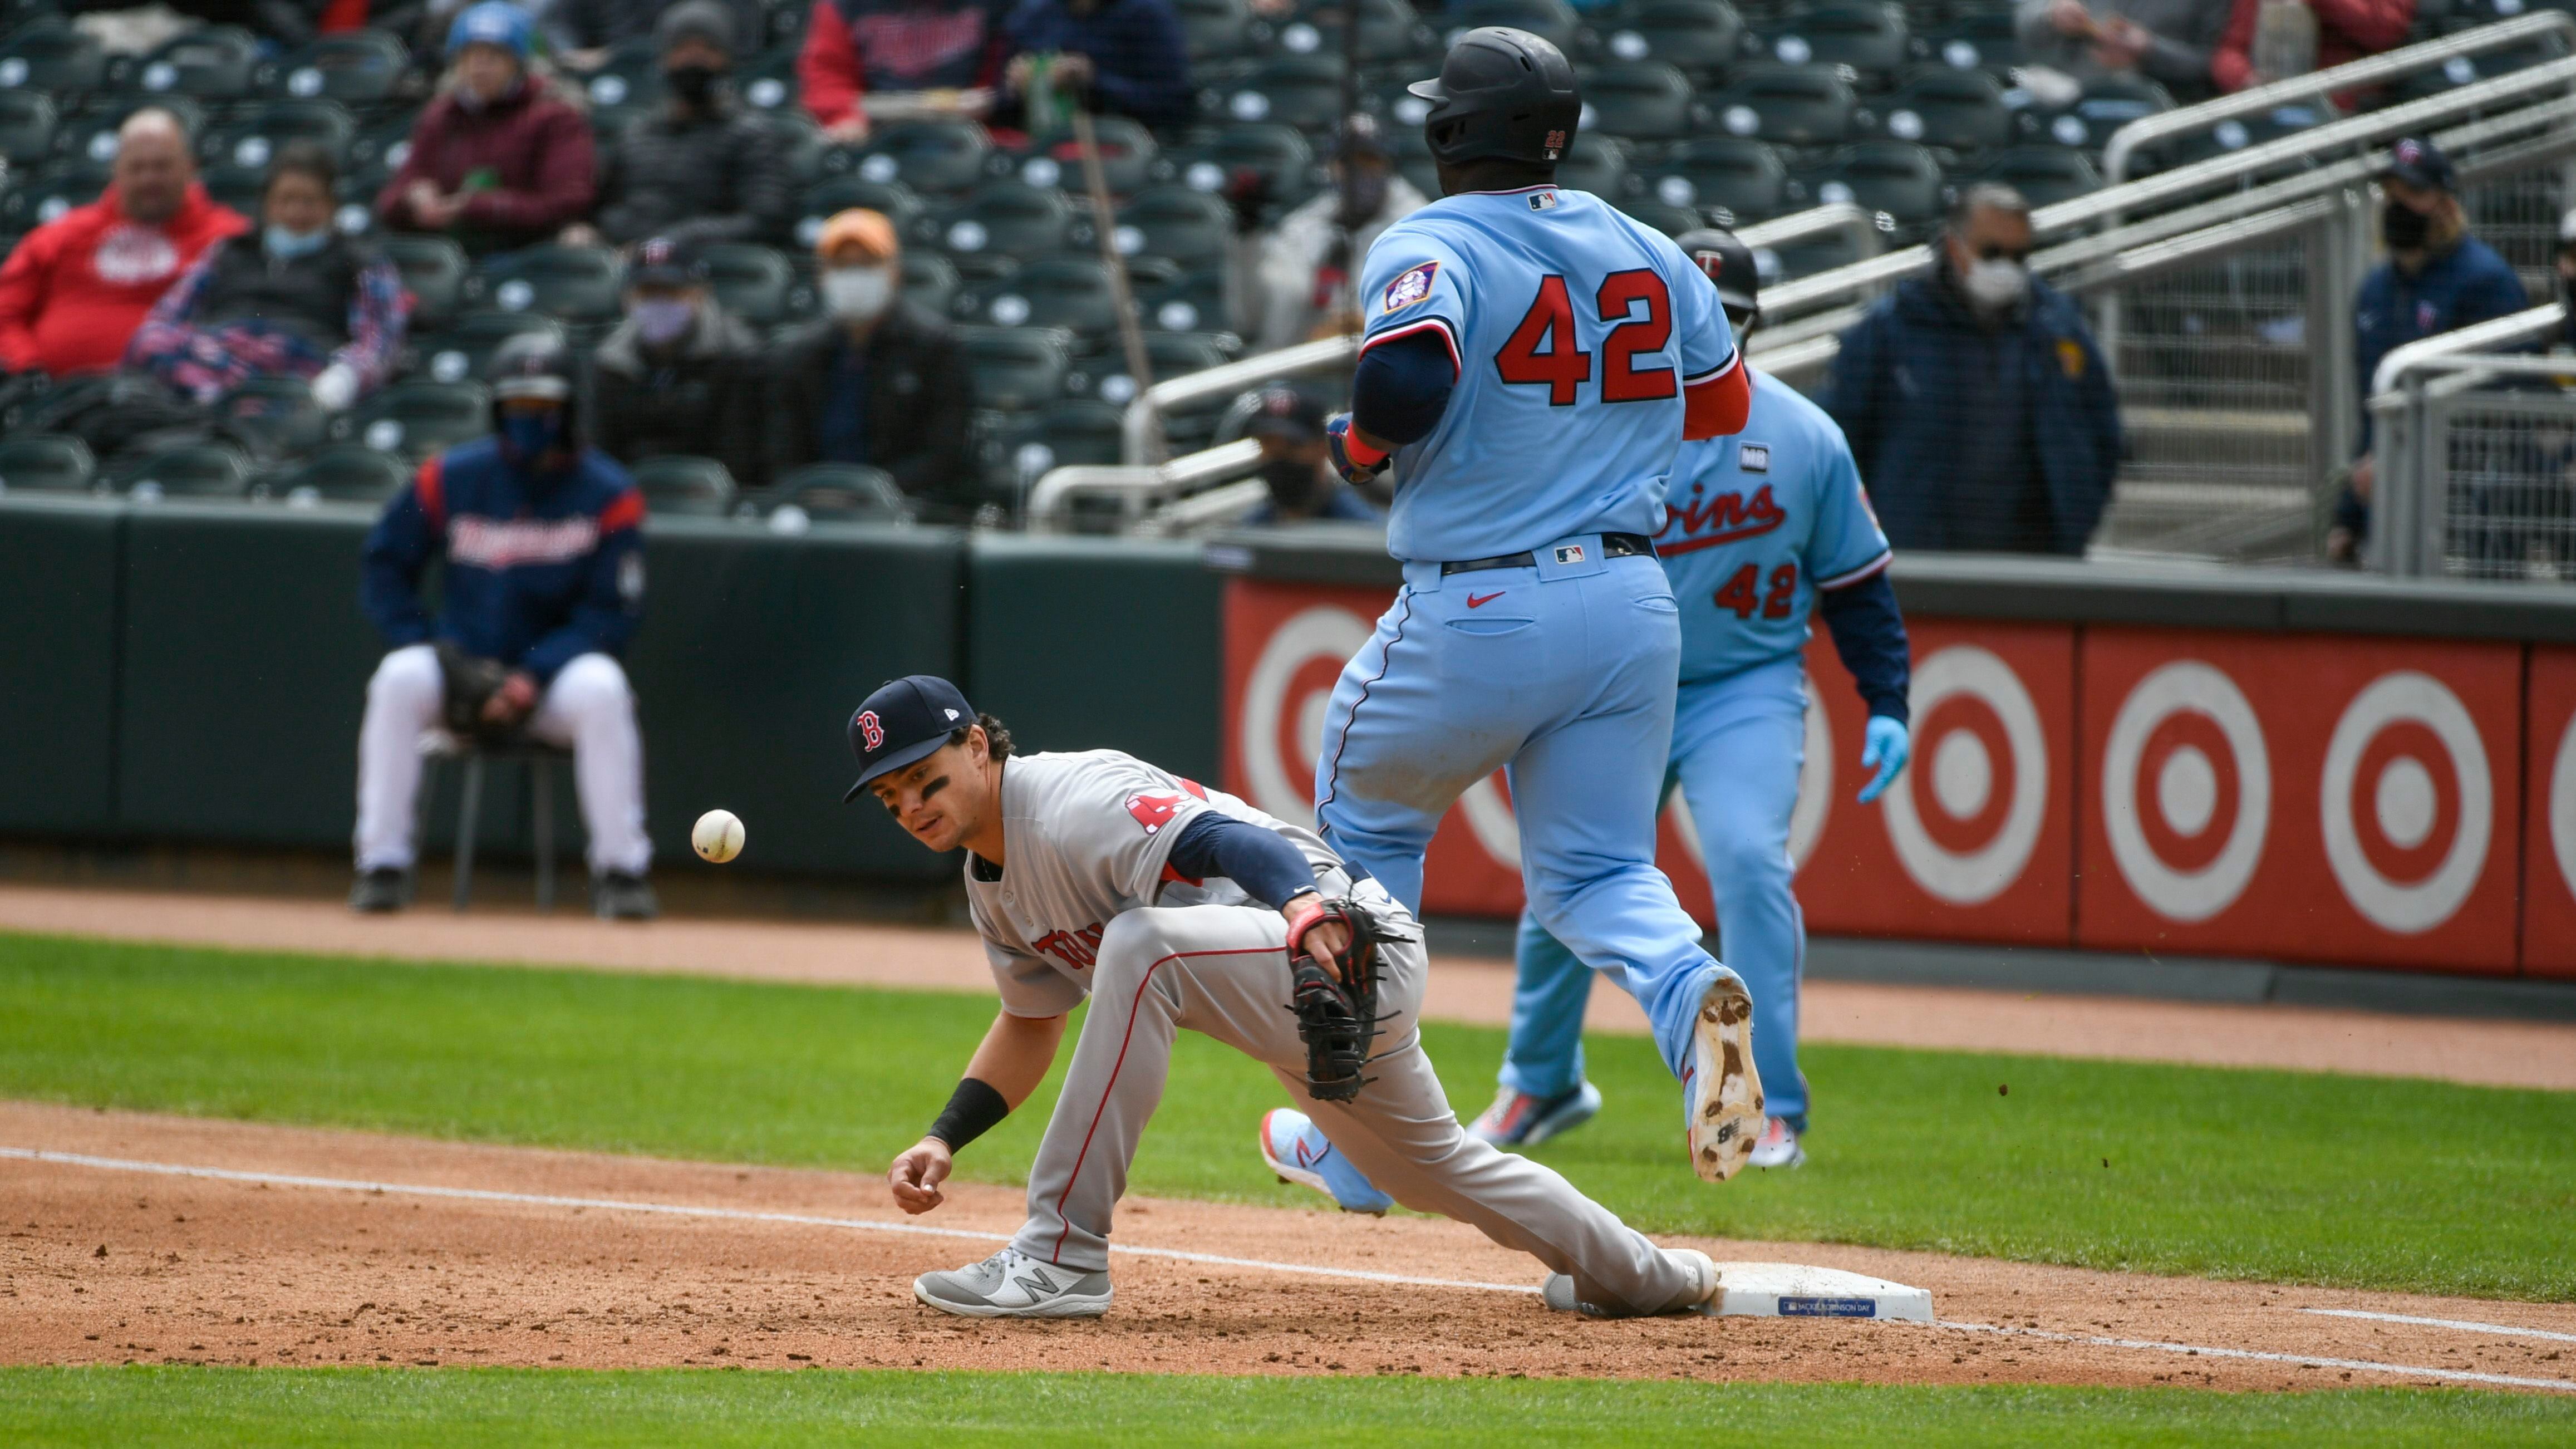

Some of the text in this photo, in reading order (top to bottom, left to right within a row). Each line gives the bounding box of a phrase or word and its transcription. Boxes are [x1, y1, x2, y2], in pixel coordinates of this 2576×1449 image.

[1545, 130, 1565, 148] 22
[1493, 266, 1678, 407] 42
[1713, 562, 1797, 621] 42
[857, 710, 884, 752] B
